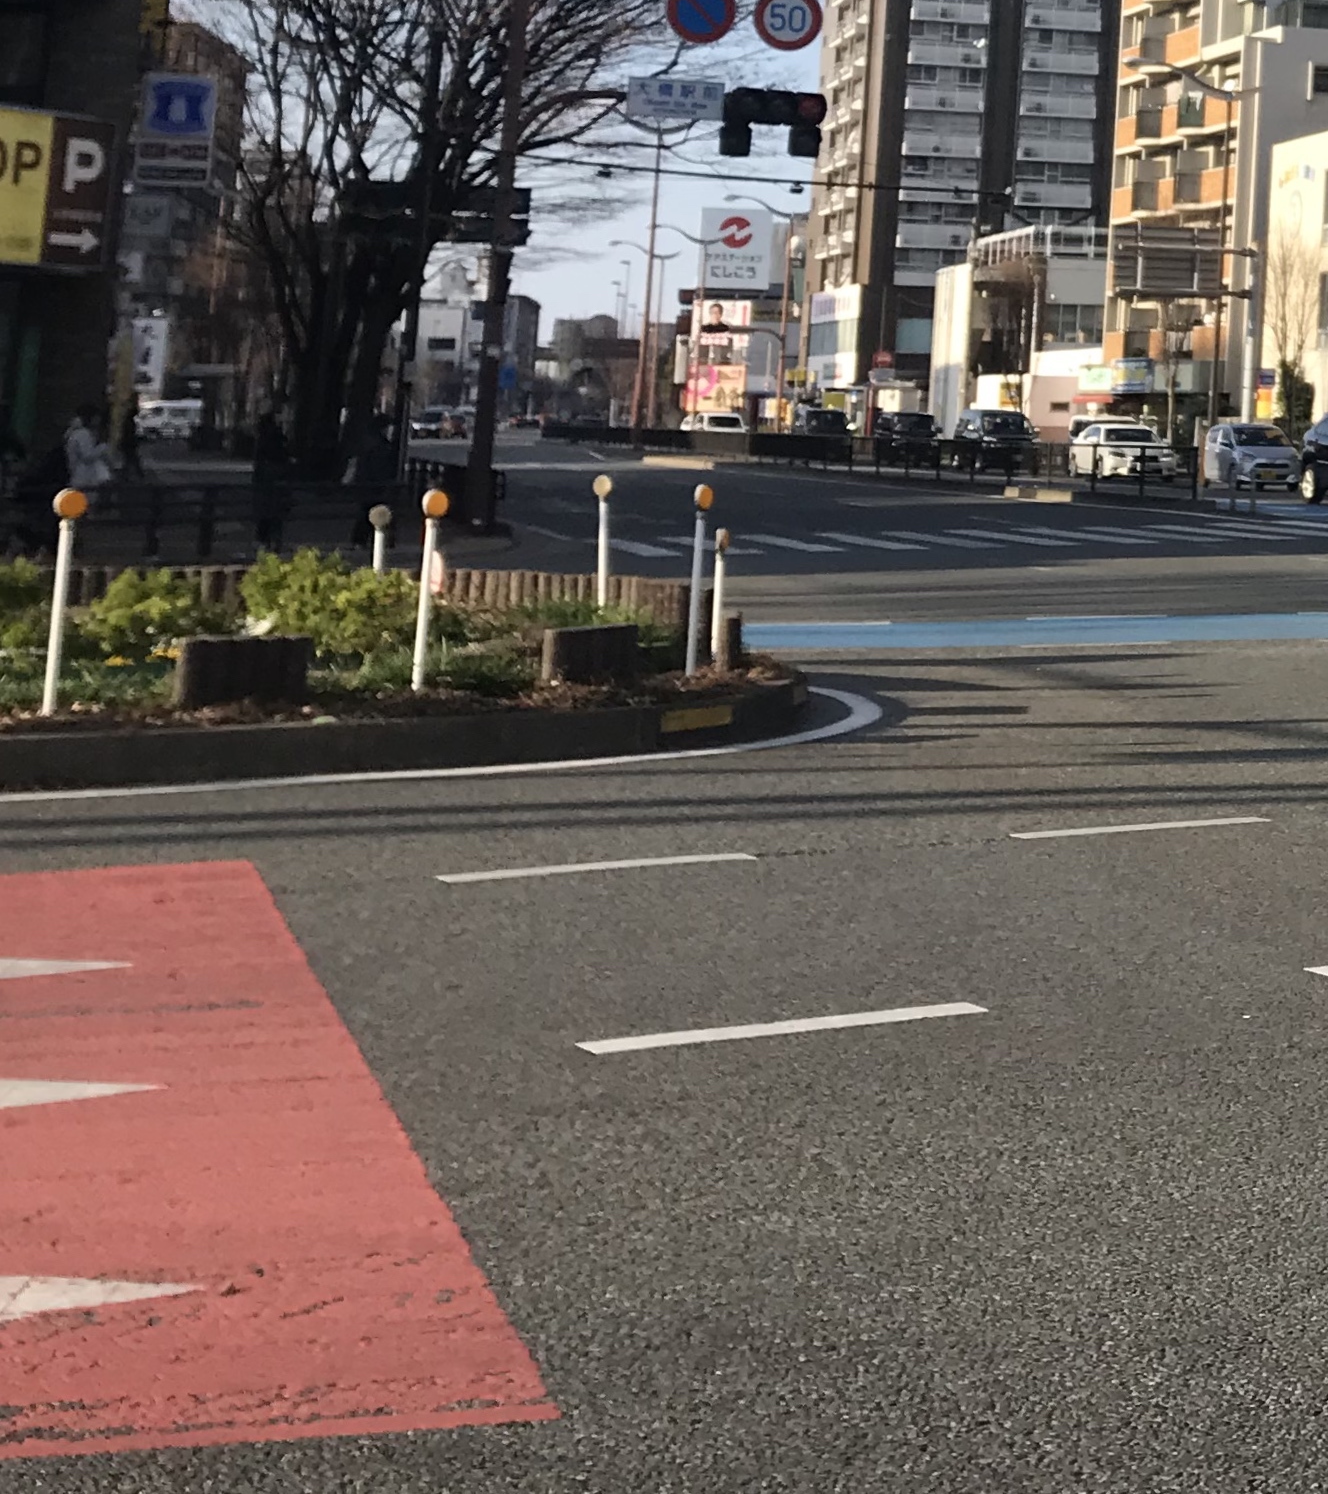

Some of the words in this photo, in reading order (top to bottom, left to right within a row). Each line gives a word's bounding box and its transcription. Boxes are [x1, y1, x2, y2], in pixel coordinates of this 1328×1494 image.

[769, 4, 807, 33] 50
[62, 137, 105, 194] P
[710, 266, 757, 280] にしこう
